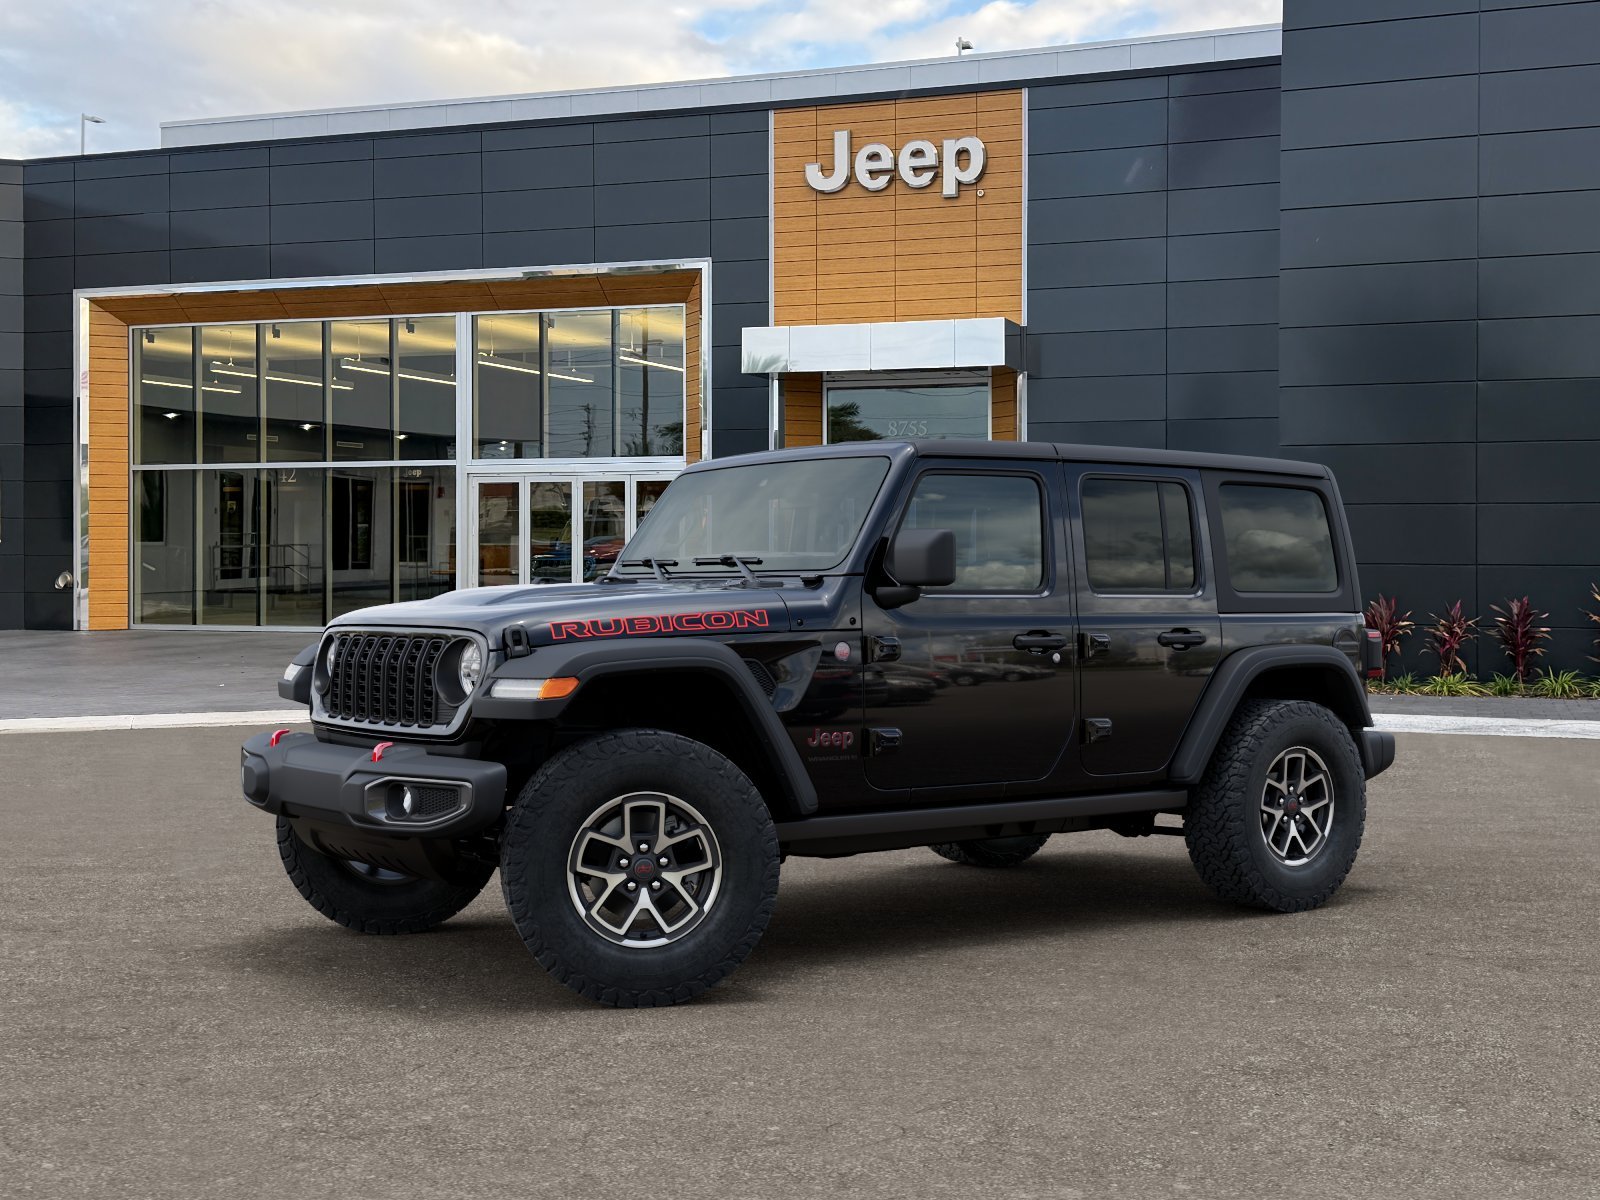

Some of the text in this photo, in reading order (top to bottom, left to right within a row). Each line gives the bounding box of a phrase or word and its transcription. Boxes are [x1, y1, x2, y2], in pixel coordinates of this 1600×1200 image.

[804, 129, 987, 198] Jeep
[888, 421, 927, 436] 8755
[550, 609, 768, 640] RUBICON
[808, 728, 854, 752] Jeep
